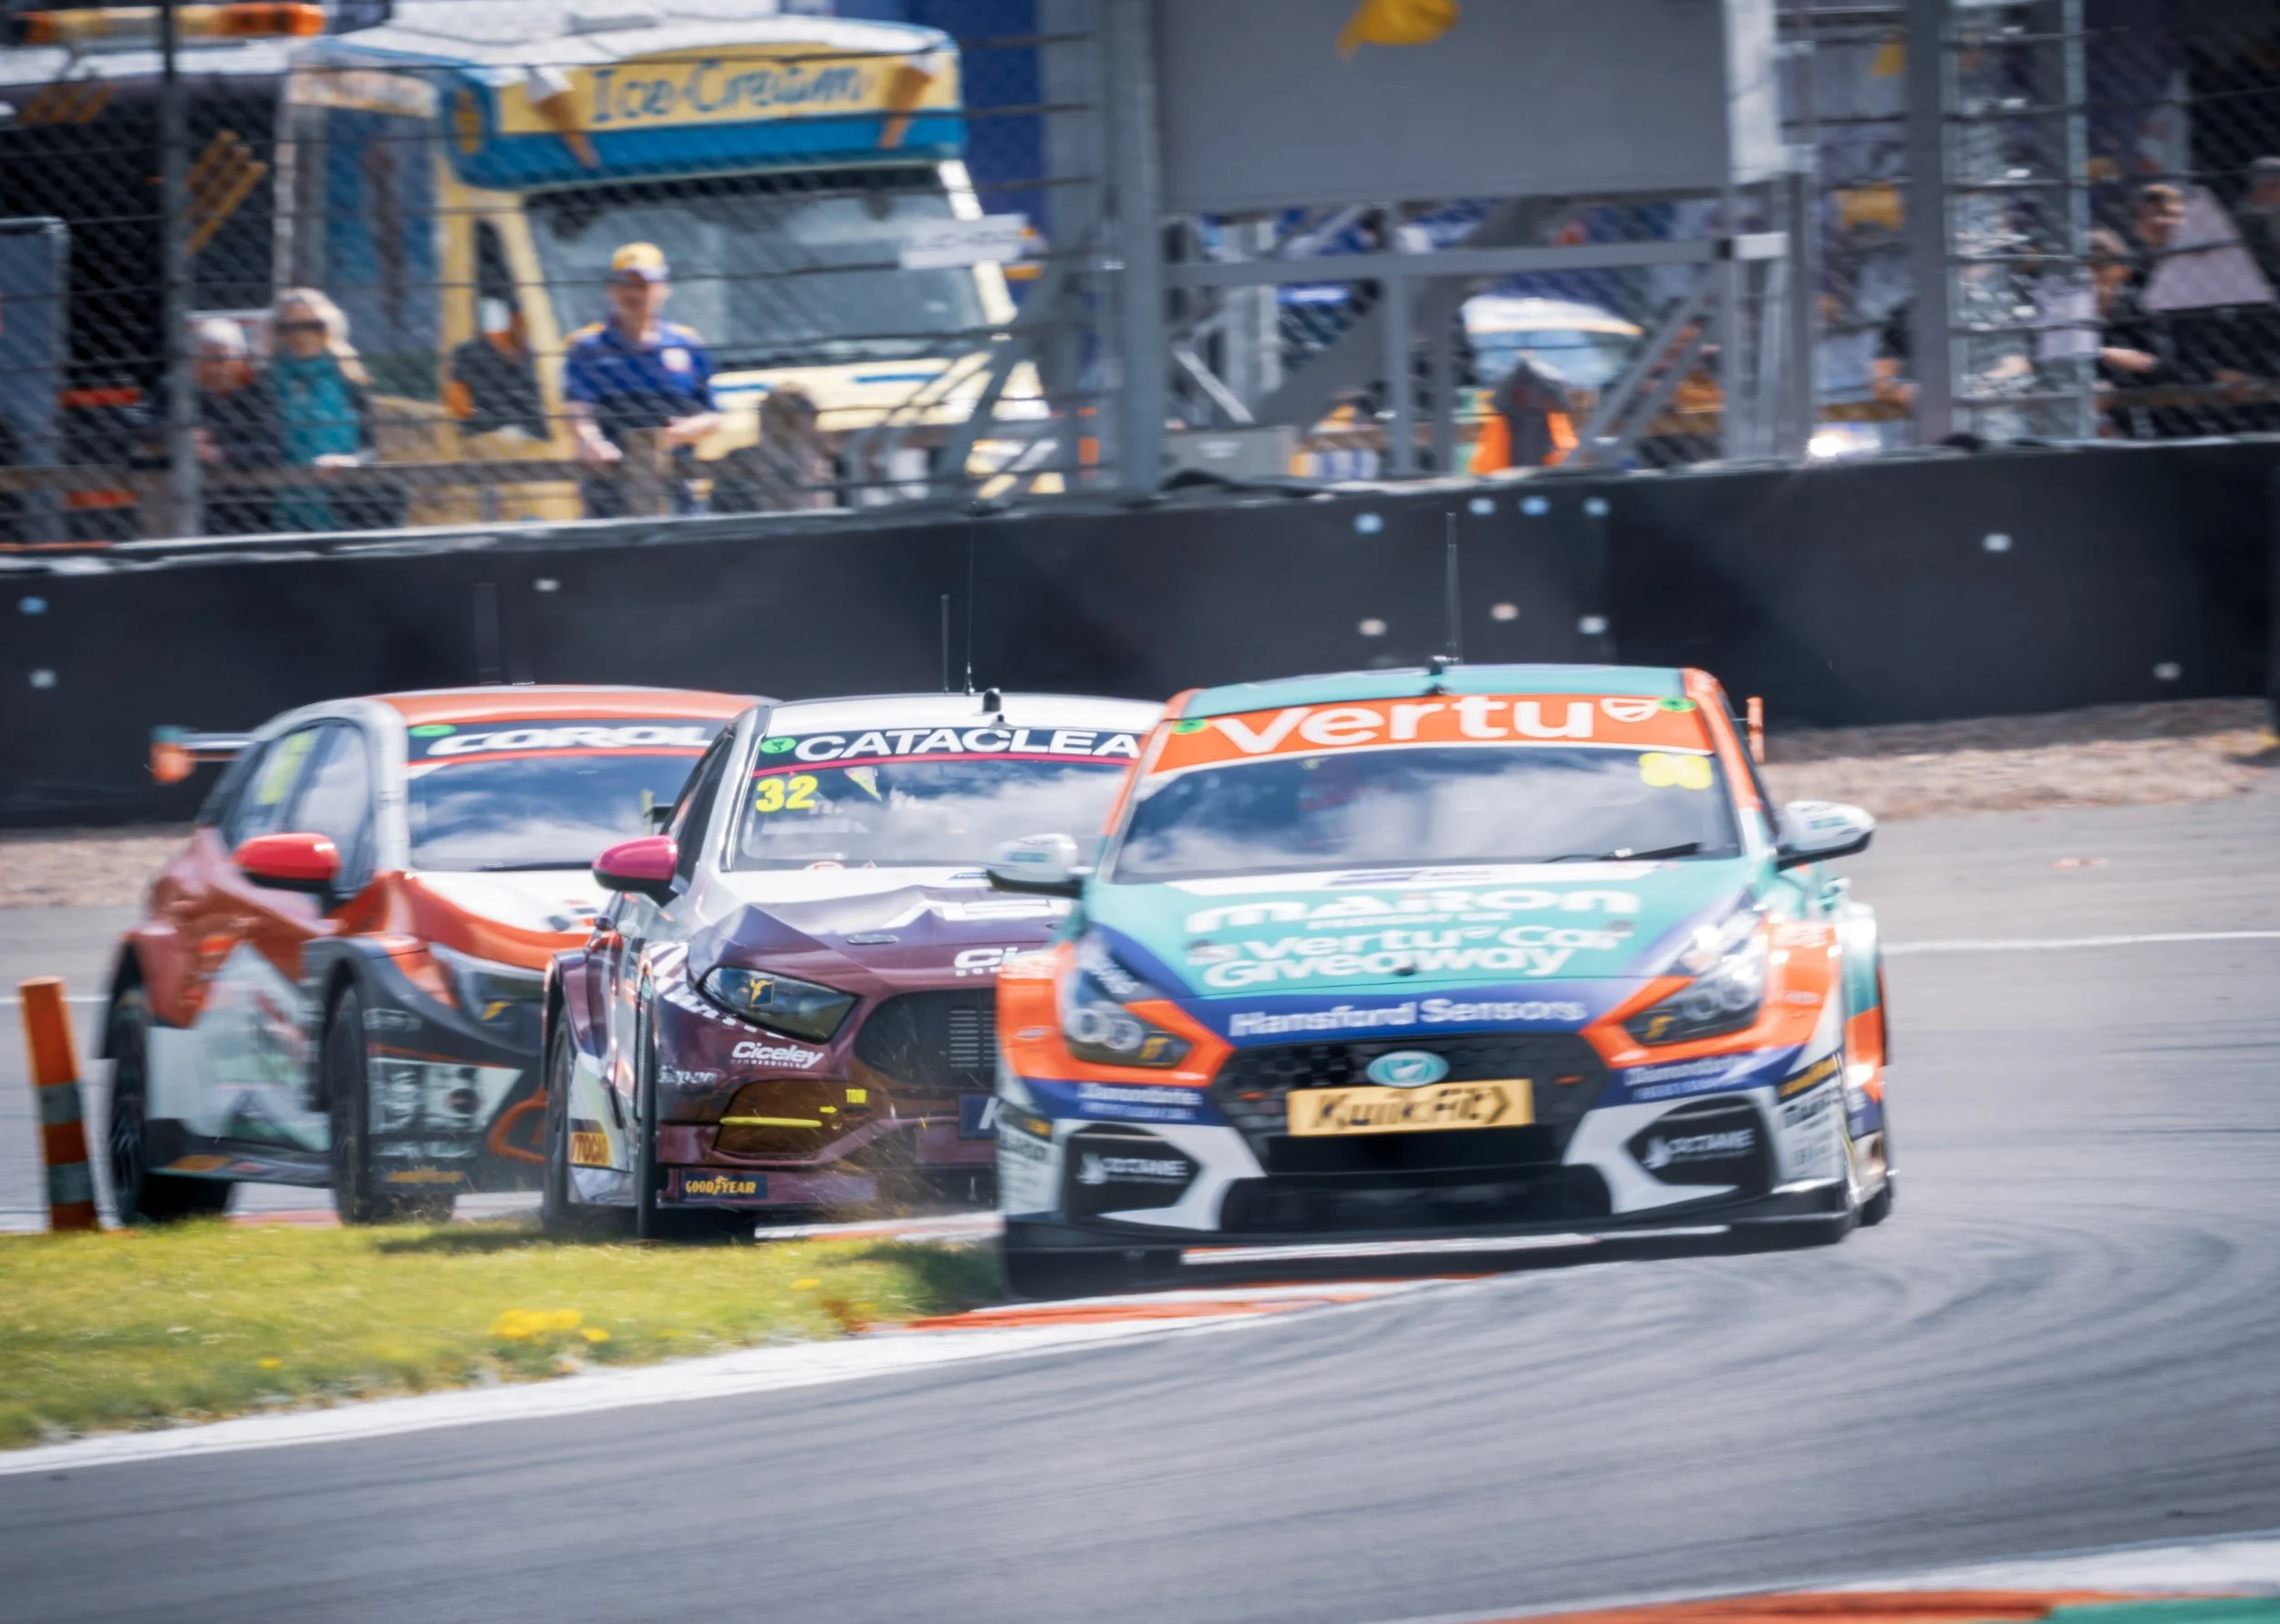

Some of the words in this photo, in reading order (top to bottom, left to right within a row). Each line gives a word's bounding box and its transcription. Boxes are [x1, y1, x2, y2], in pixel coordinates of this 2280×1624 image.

[794, 729, 1140, 762] CATACLEA
[755, 774, 818, 813] 32
[1420, 998, 1589, 1023] Sensors
[731, 1040, 824, 1070] Ciceley
[686, 1175, 757, 1195] GOODYEAR
